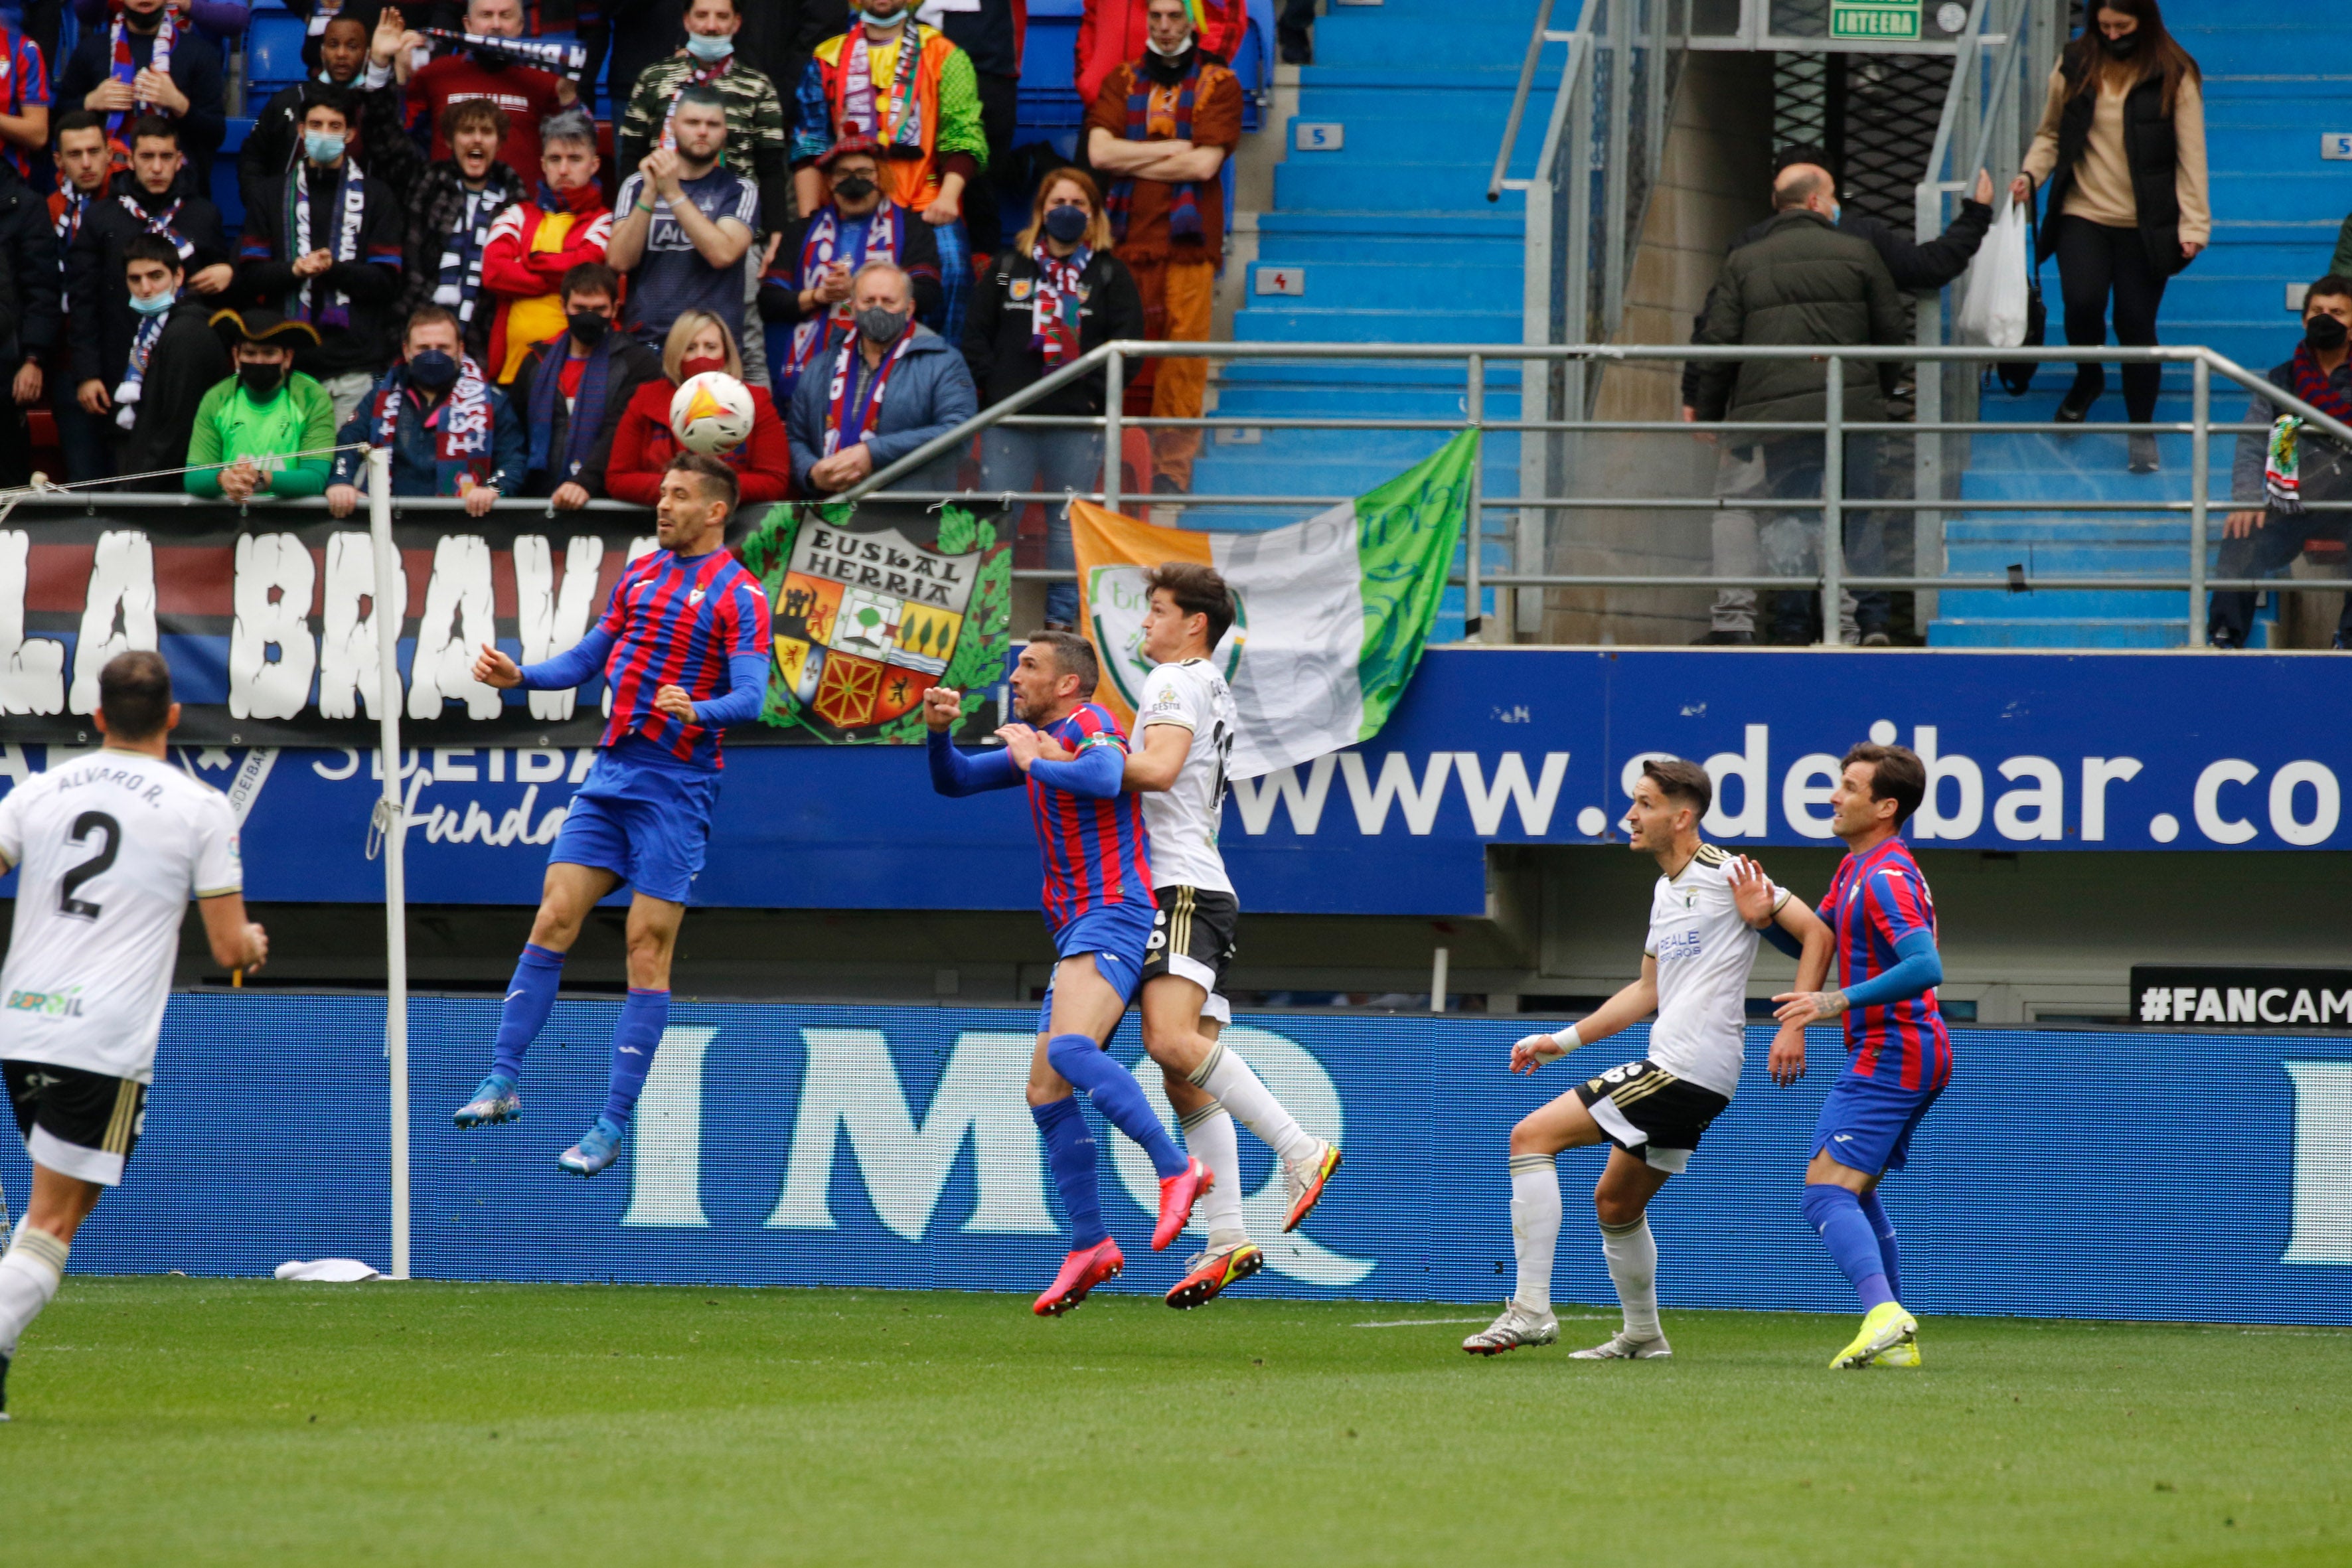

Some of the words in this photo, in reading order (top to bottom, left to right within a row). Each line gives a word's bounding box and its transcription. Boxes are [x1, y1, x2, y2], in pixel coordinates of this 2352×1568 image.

[1838, 11, 1913, 34] IRTEERA
[1312, 127, 1326, 145] 5
[2338, 138, 2351, 155] 5
[1274, 272, 1287, 291] 4
[813, 528, 962, 584] EUSKAL
[0, 529, 159, 716] LA
[228, 530, 659, 721] BRAV
[58, 767, 145, 793] ALVARO
[143, 784, 164, 809] R.
[1229, 719, 2341, 846] www.debar.co
[55, 810, 121, 922] 2
[1660, 931, 1700, 950] REALE
[2140, 986, 2352, 1024] #FANCAM
[621, 1025, 1378, 1285] IMQ
